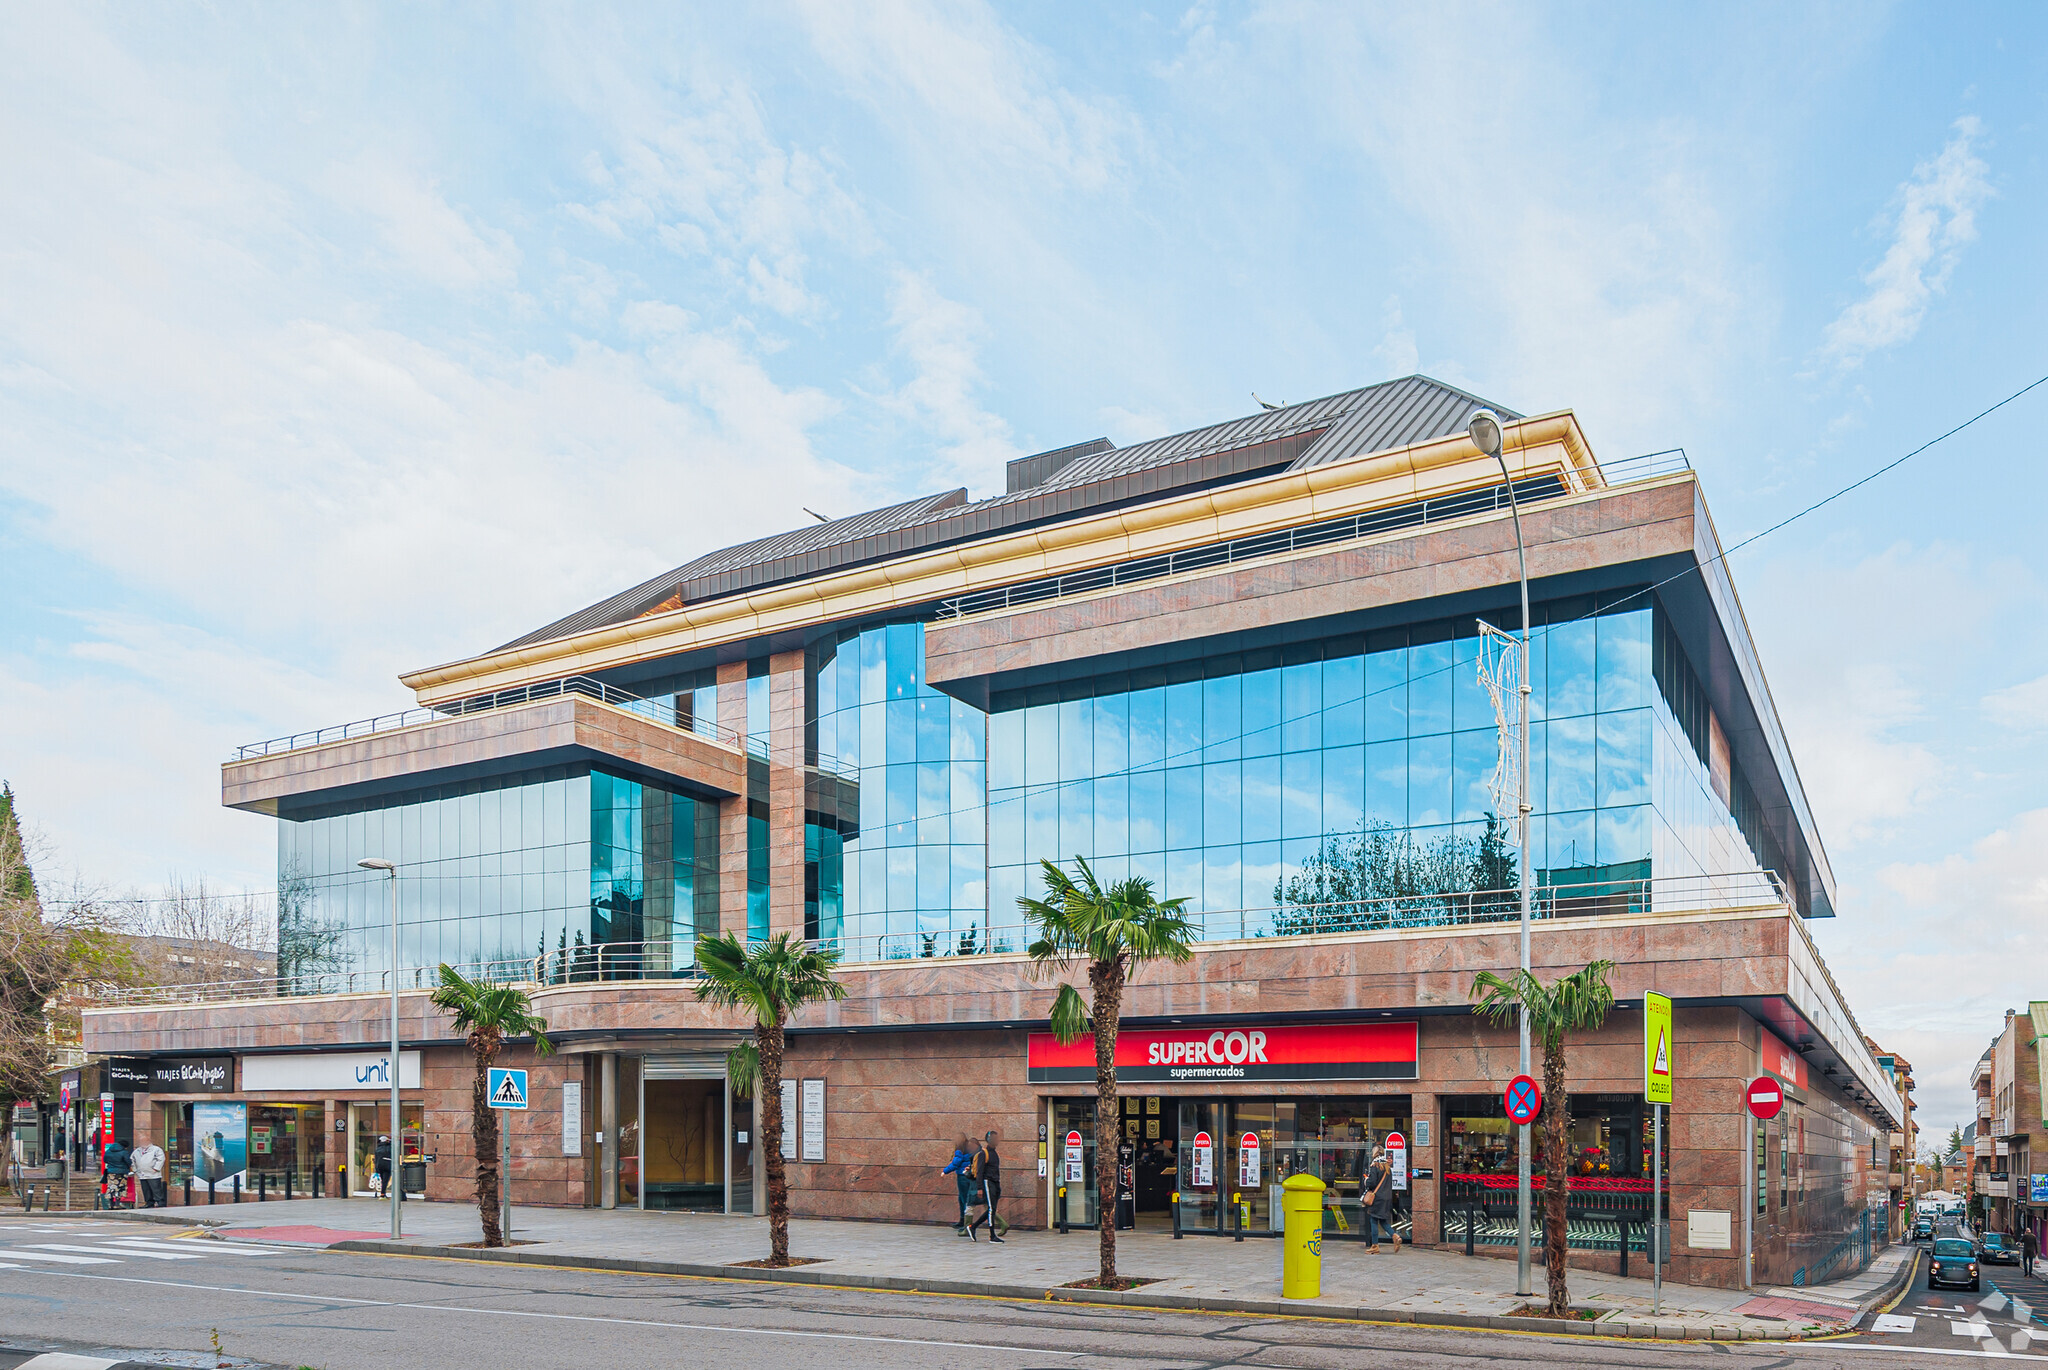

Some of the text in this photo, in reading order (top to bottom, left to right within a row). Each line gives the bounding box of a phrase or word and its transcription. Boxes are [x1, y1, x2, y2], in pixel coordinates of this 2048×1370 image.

[1148, 1031, 1268, 1064] SUPERCOR
[156, 1070, 180, 1082] VIAJES
[355, 1058, 389, 1083] unit
[1170, 1065, 1244, 1080] supermercados
